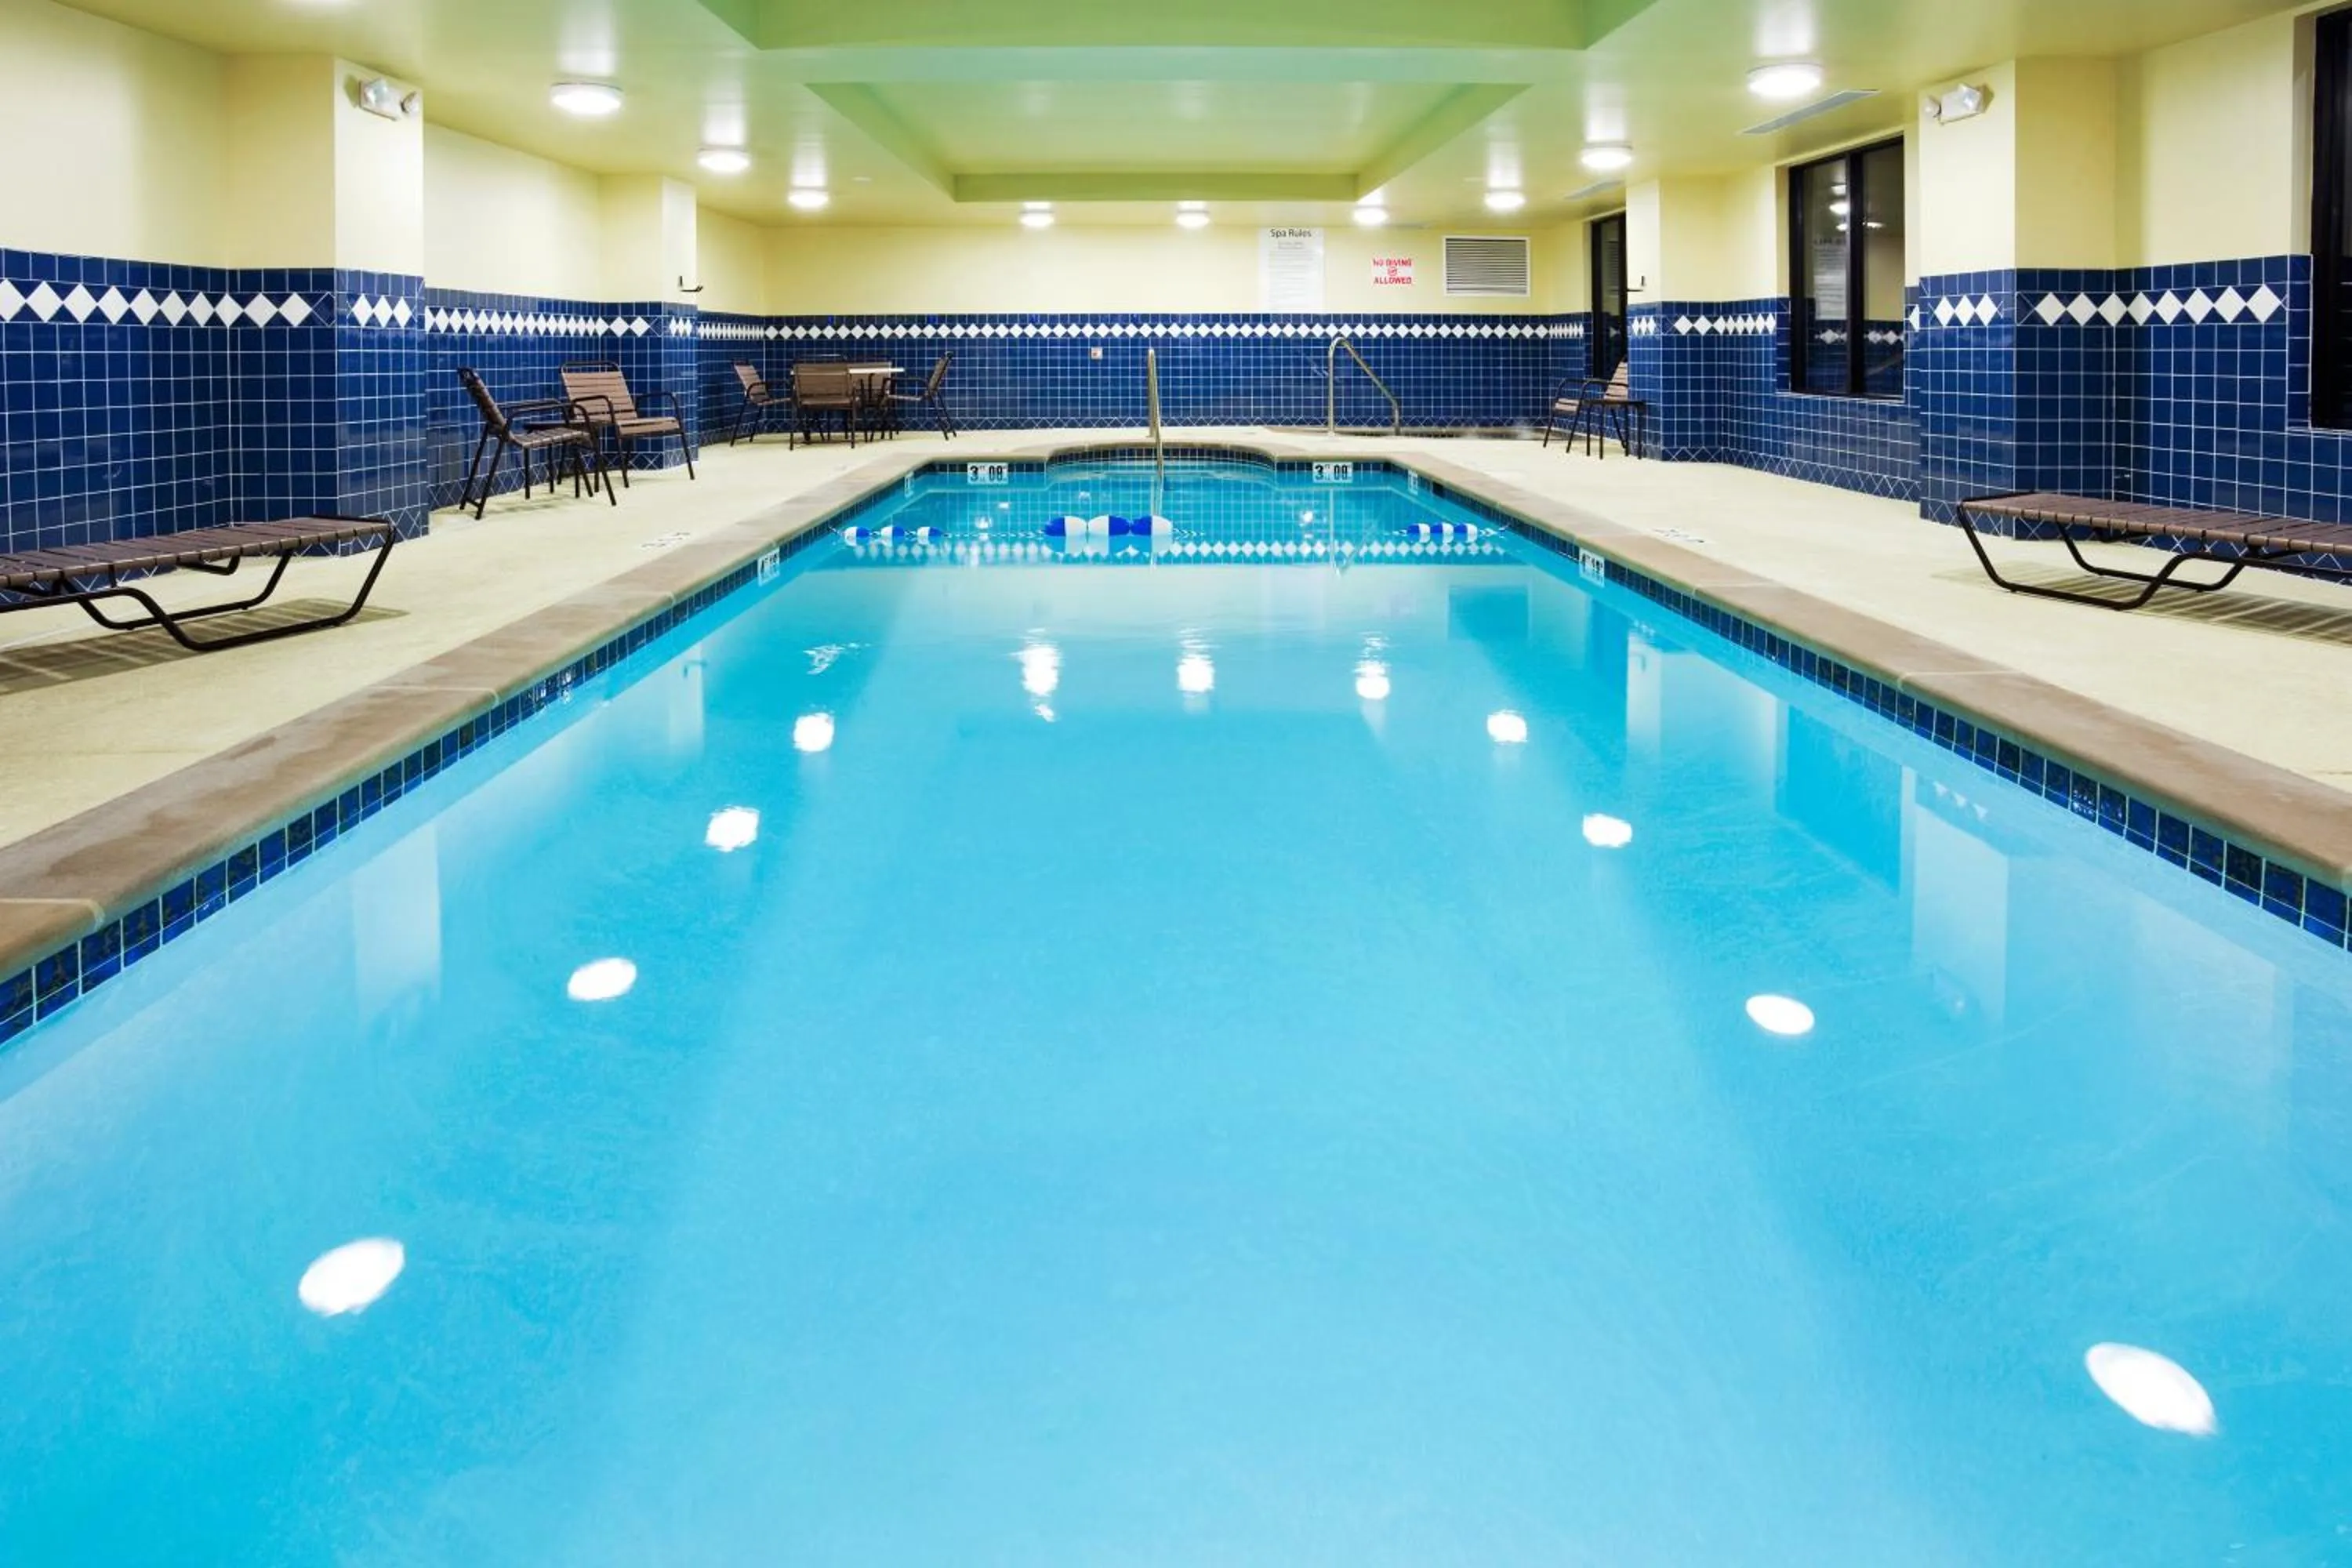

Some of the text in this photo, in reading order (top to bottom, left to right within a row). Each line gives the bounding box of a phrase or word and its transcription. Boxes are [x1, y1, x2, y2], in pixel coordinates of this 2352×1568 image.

[1269, 228, 1312, 238] Spa Rules
[1373, 276, 1412, 285] ALLOWED
